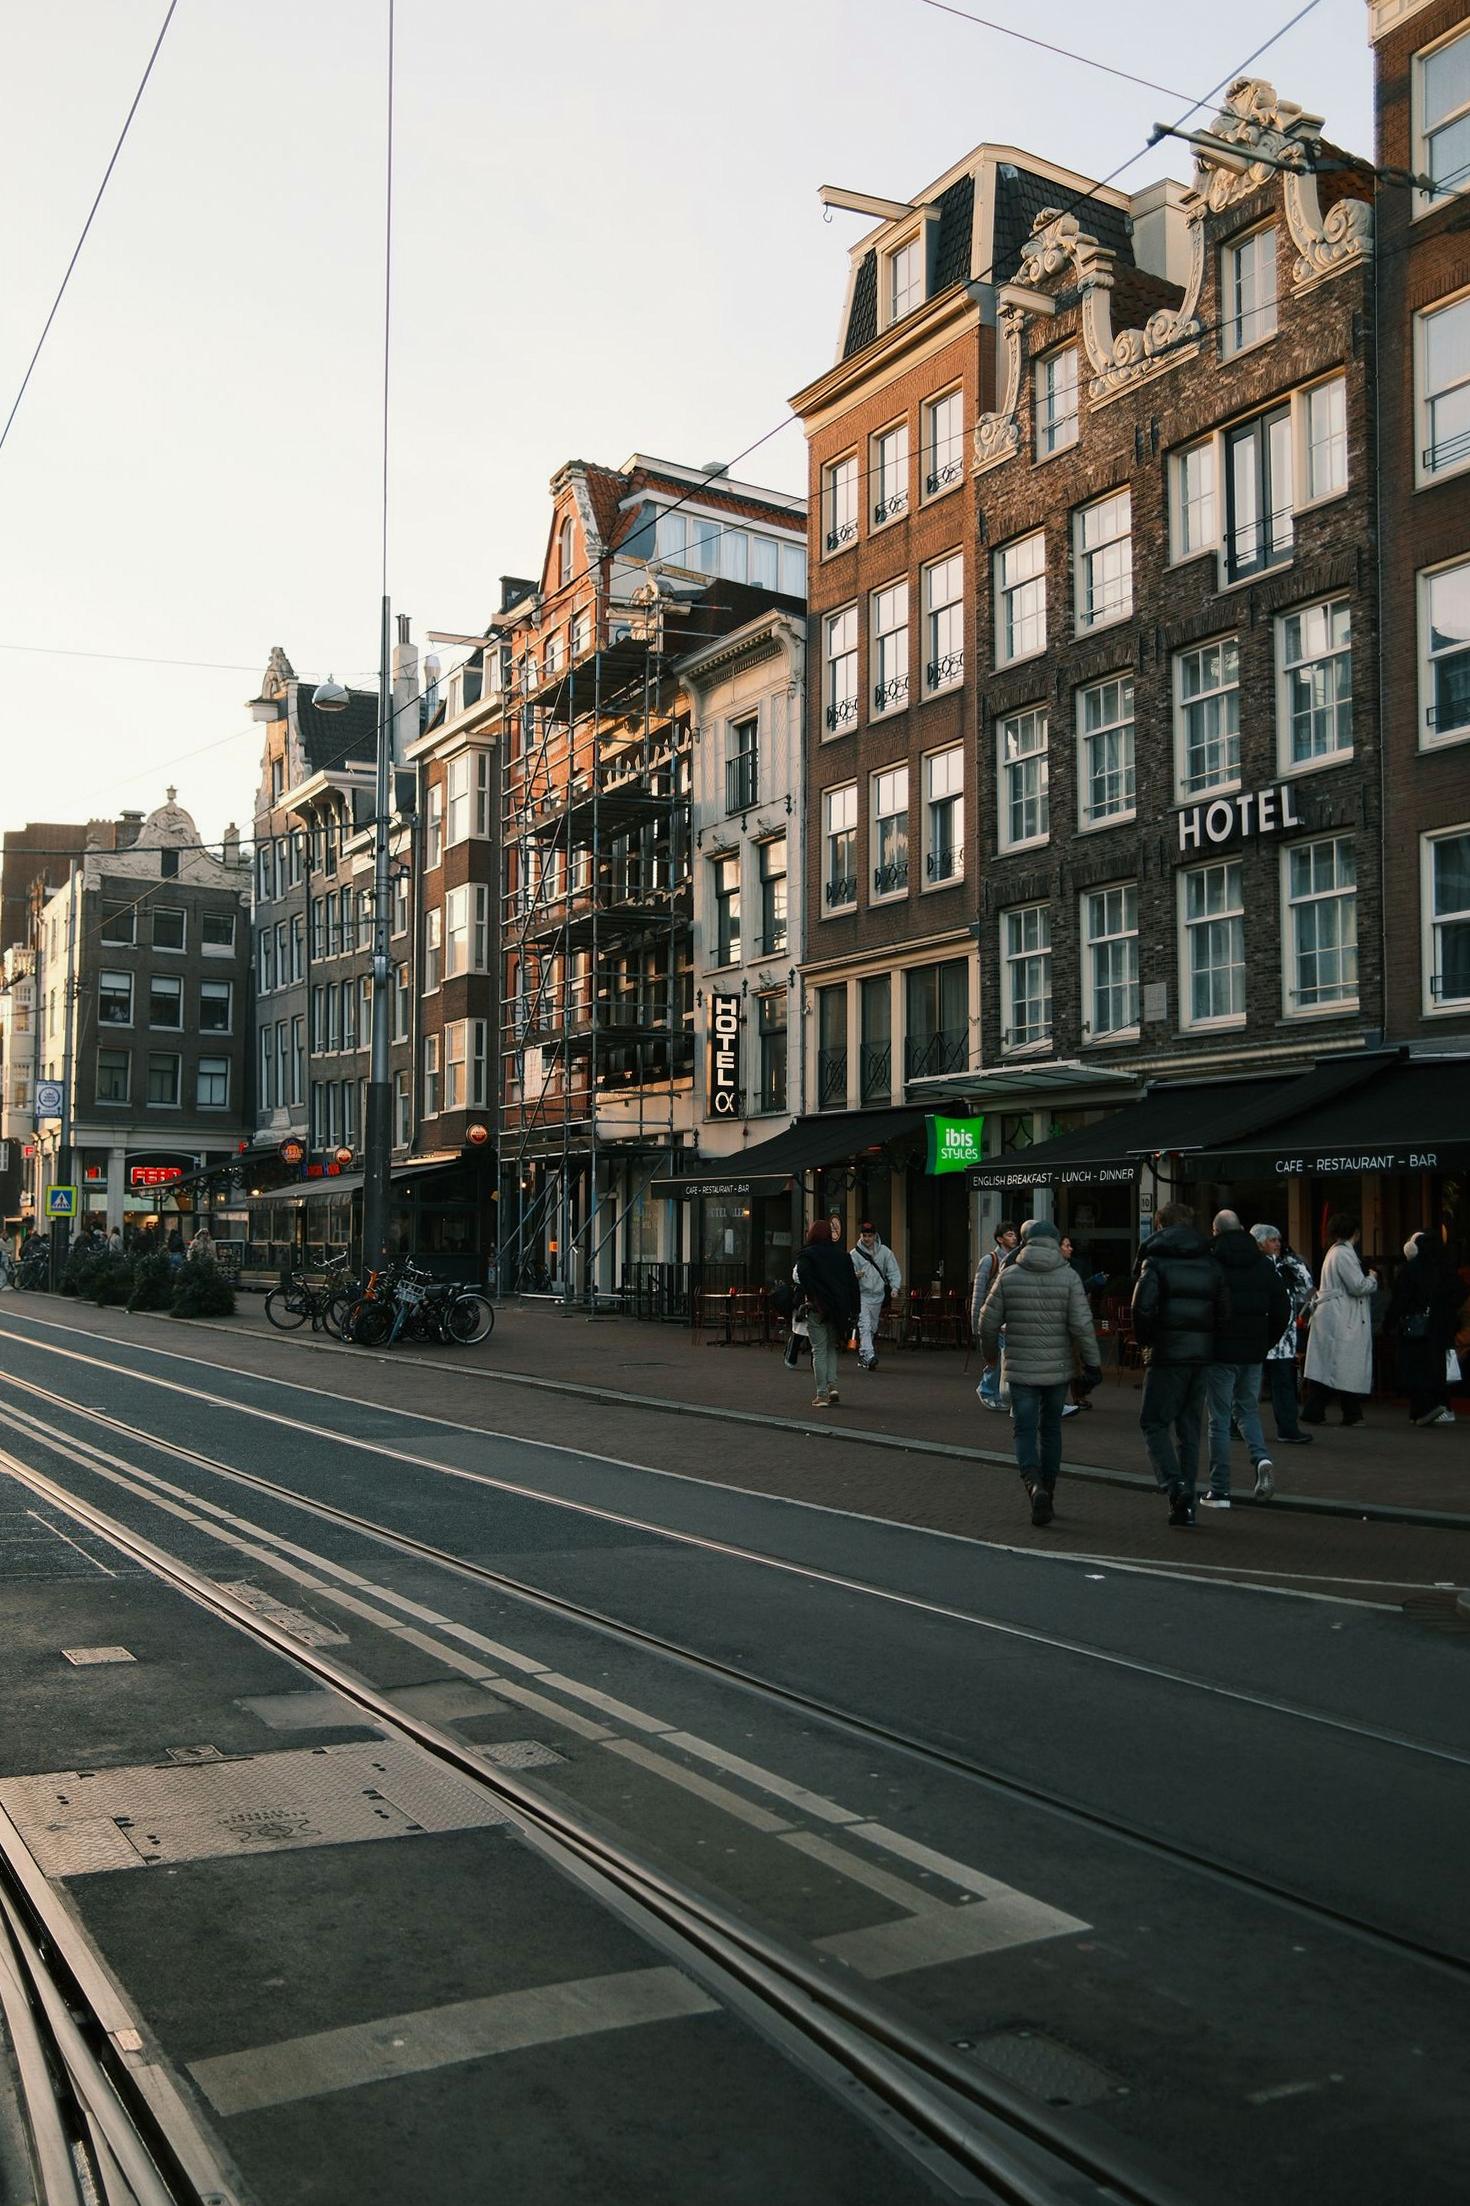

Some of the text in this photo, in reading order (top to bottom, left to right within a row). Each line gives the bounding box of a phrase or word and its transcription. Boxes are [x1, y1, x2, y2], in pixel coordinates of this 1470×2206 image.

[1178, 786, 1299, 851] HOTEL
[715, 997, 738, 1087] HOTEL
[945, 1128, 974, 1147] ibis
[25, 1146, 34, 1156] F
[1275, 1159, 1304, 1173] CAFE
[1316, 1155, 1395, 1171] RESTAURANT
[1409, 1153, 1438, 1168] BAR
[972, 1175, 1006, 1187] ENGLISH
[1006, 1172, 1053, 1185] BREAKFAST
[1061, 1170, 1092, 1183] LUNCH
[1099, 1168, 1134, 1181] DINNER
[685, 1186, 698, 1195] CAFE
[702, 1184, 733, 1194] RESTAURANT
[737, 1184, 750, 1193] BAR
[1141, 1198, 1150, 1208] 10
